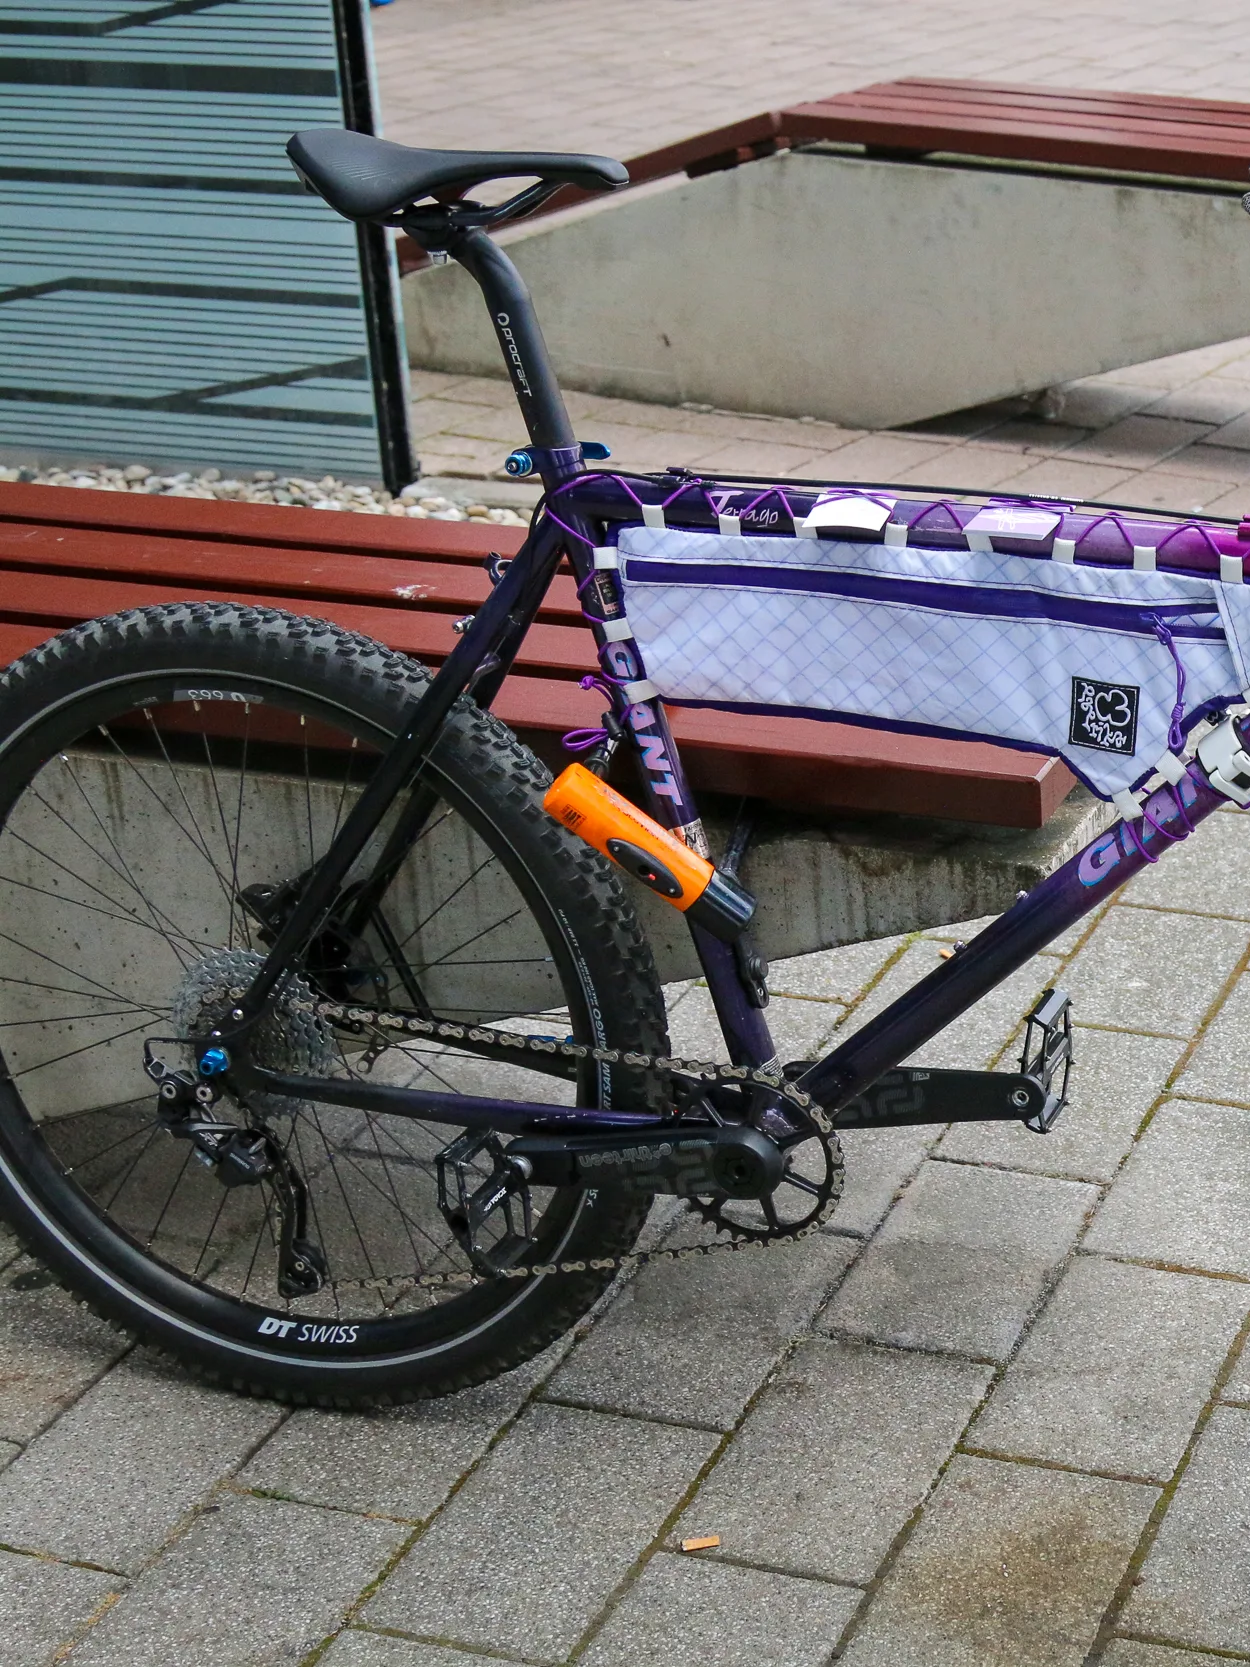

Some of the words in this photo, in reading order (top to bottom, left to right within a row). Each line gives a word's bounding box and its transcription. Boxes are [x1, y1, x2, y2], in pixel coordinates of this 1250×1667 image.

[606, 640, 684, 806] GANT
[593, 1009, 608, 1052] ARGO
[258, 1317, 298, 1338] DT
[297, 1324, 360, 1343] SWISS
